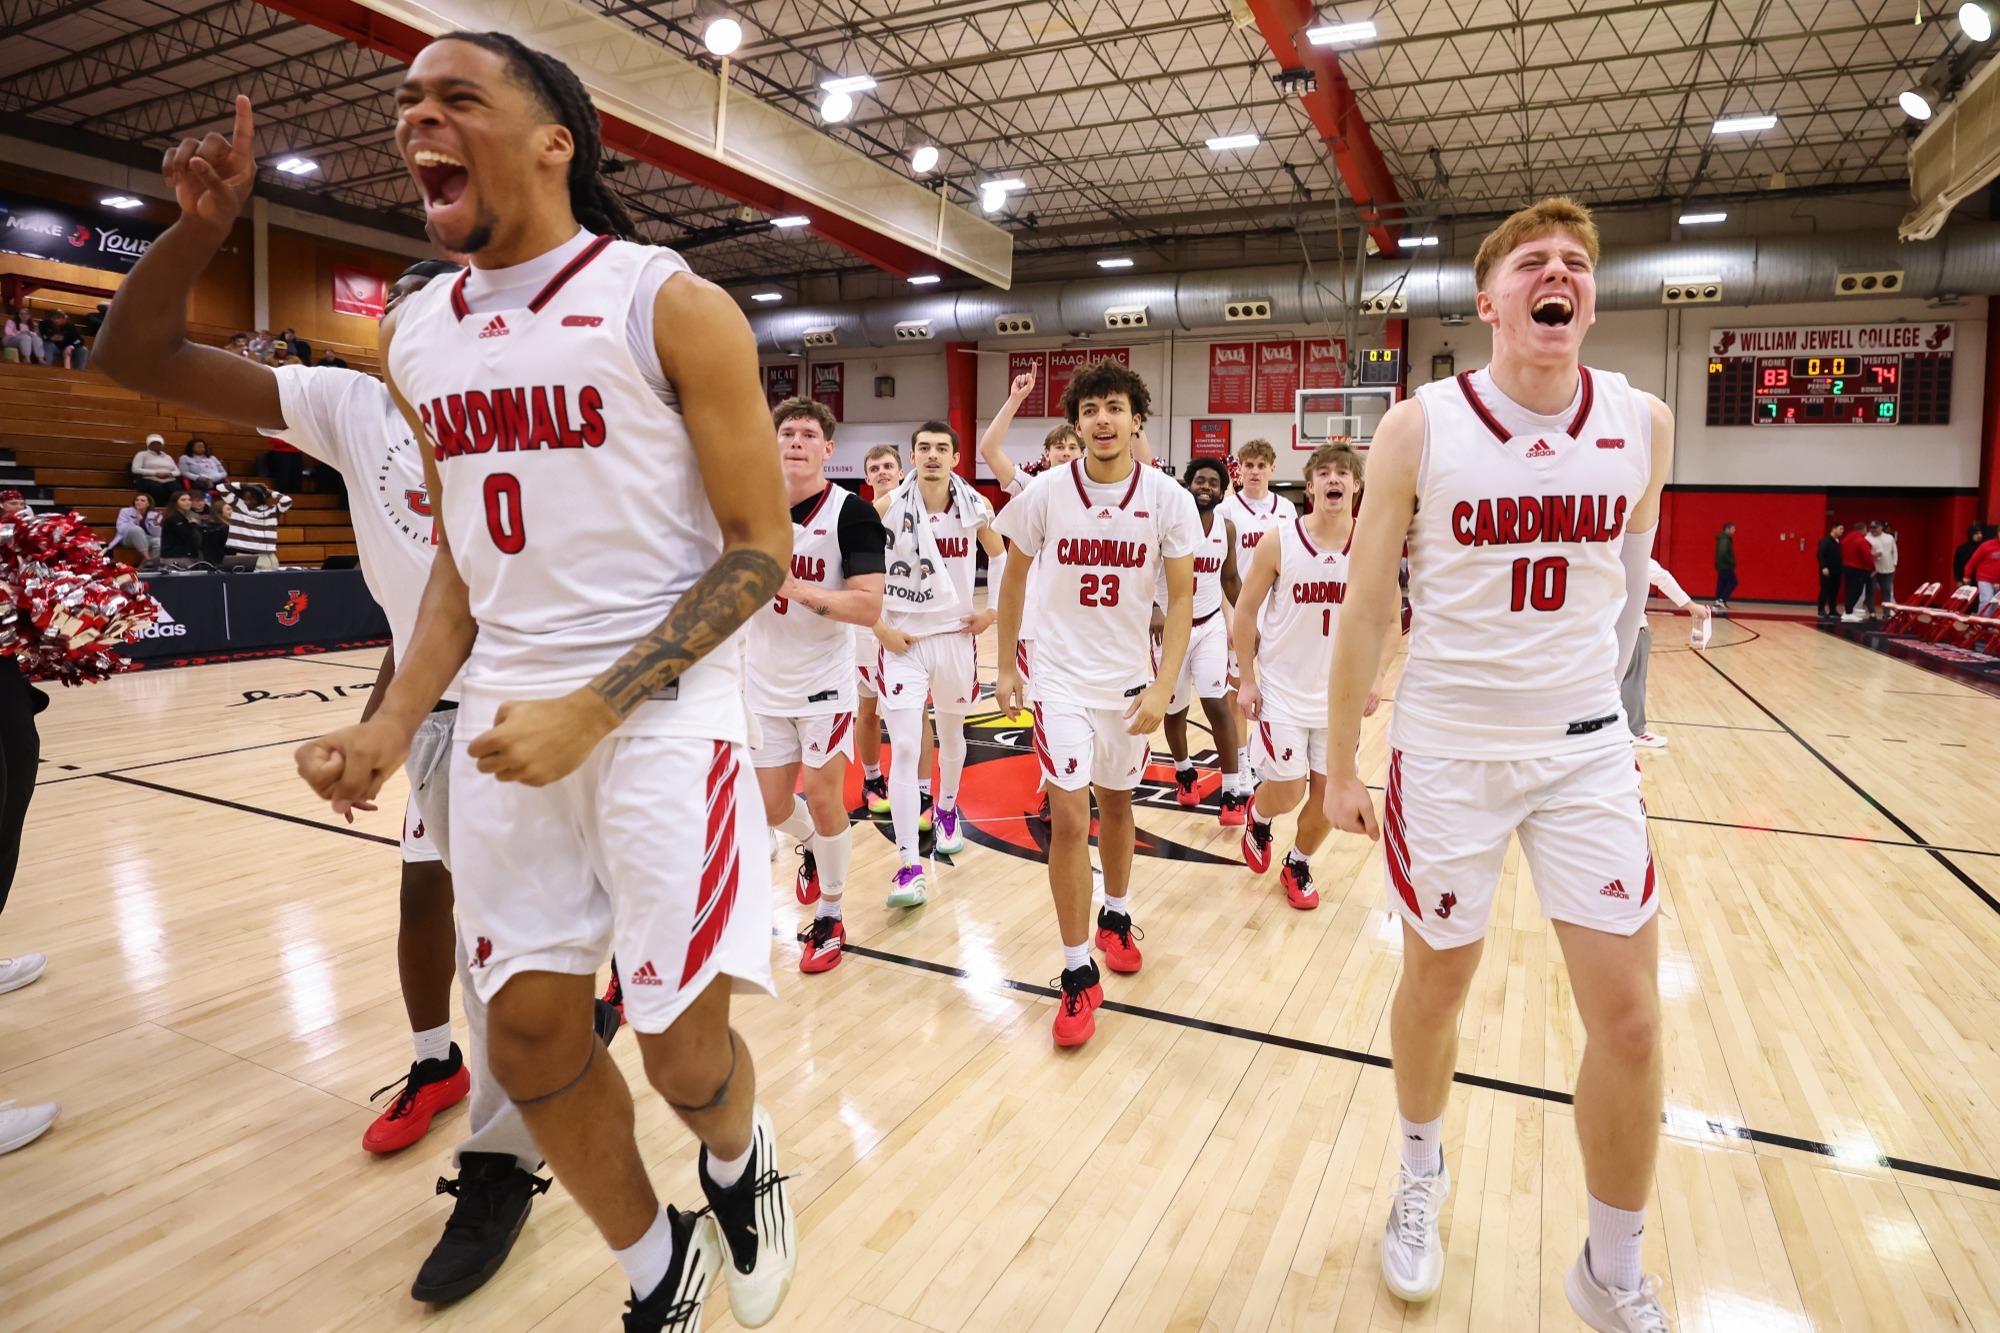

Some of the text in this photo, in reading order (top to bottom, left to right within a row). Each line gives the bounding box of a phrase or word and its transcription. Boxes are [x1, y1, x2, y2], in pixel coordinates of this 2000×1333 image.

[6, 216, 63, 237] MAKE
[479, 329, 510, 339] adidas
[1741, 328, 1920, 351] WILLIAM JEWELL COLLEGE
[1012, 356, 1043, 368] HAAC
[1051, 354, 1084, 366] HAAC
[1762, 359, 1787, 367] HOME
[1863, 356, 1899, 365] VISITOR
[1709, 363, 1723, 373] 09
[1871, 367, 1896, 384] 74
[1764, 369, 1788, 386] 83
[1833, 380, 1844, 395] 2
[1767, 404, 1777, 418] 7
[1787, 408, 1795, 418] 2
[1879, 402, 1894, 417] 10
[420, 385, 607, 462] CARDINALS
[1526, 449, 1556, 458] adidas
[482, 472, 526, 555] 0
[1452, 495, 1627, 547] CARDINALS
[1057, 538, 1147, 568] CARDINALS
[1080, 573, 1120, 608] 23
[1510, 556, 1570, 612] 10
[1323, 608, 1331, 637] 1
[1600, 888, 1630, 900] adidas
